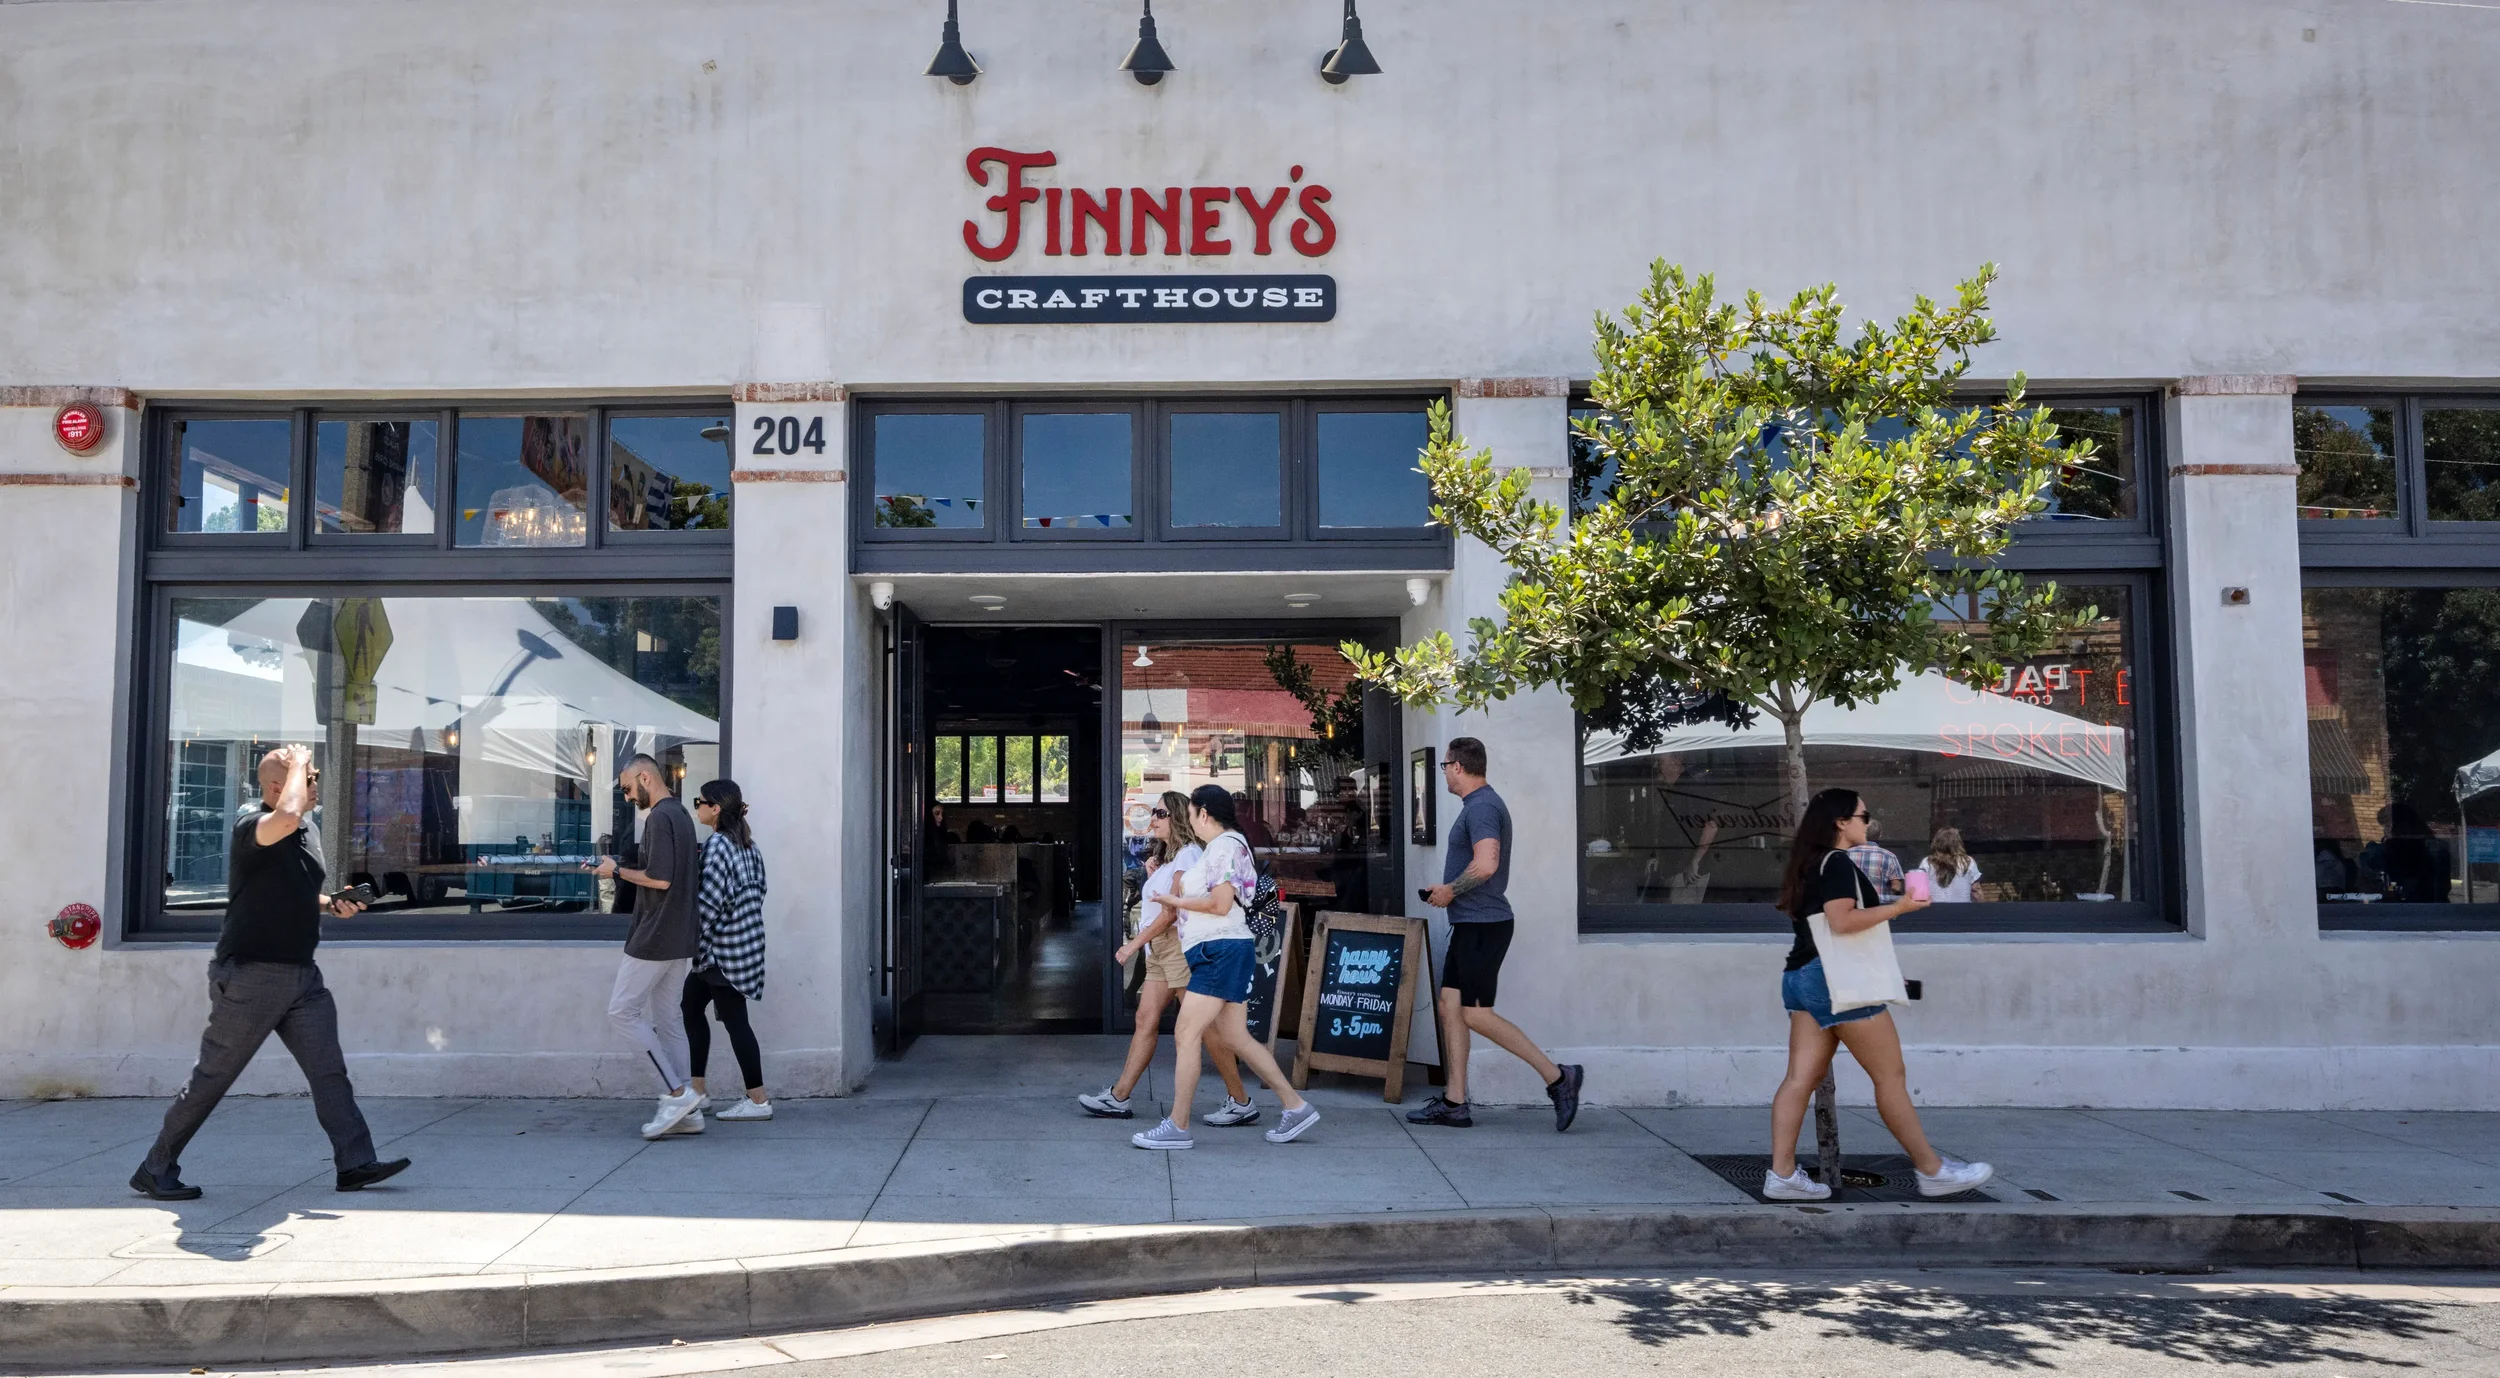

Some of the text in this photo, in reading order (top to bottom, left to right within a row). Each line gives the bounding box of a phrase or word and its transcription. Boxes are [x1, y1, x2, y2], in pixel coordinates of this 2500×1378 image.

[963, 147, 1336, 262] FINNEY'S
[976, 288, 1324, 309] CRAFTHOUSE
[753, 416, 826, 455] 204
[1940, 721, 2111, 757] SPOKEN
[1339, 946, 1391, 971] happy
[1338, 965, 1381, 984] hour
